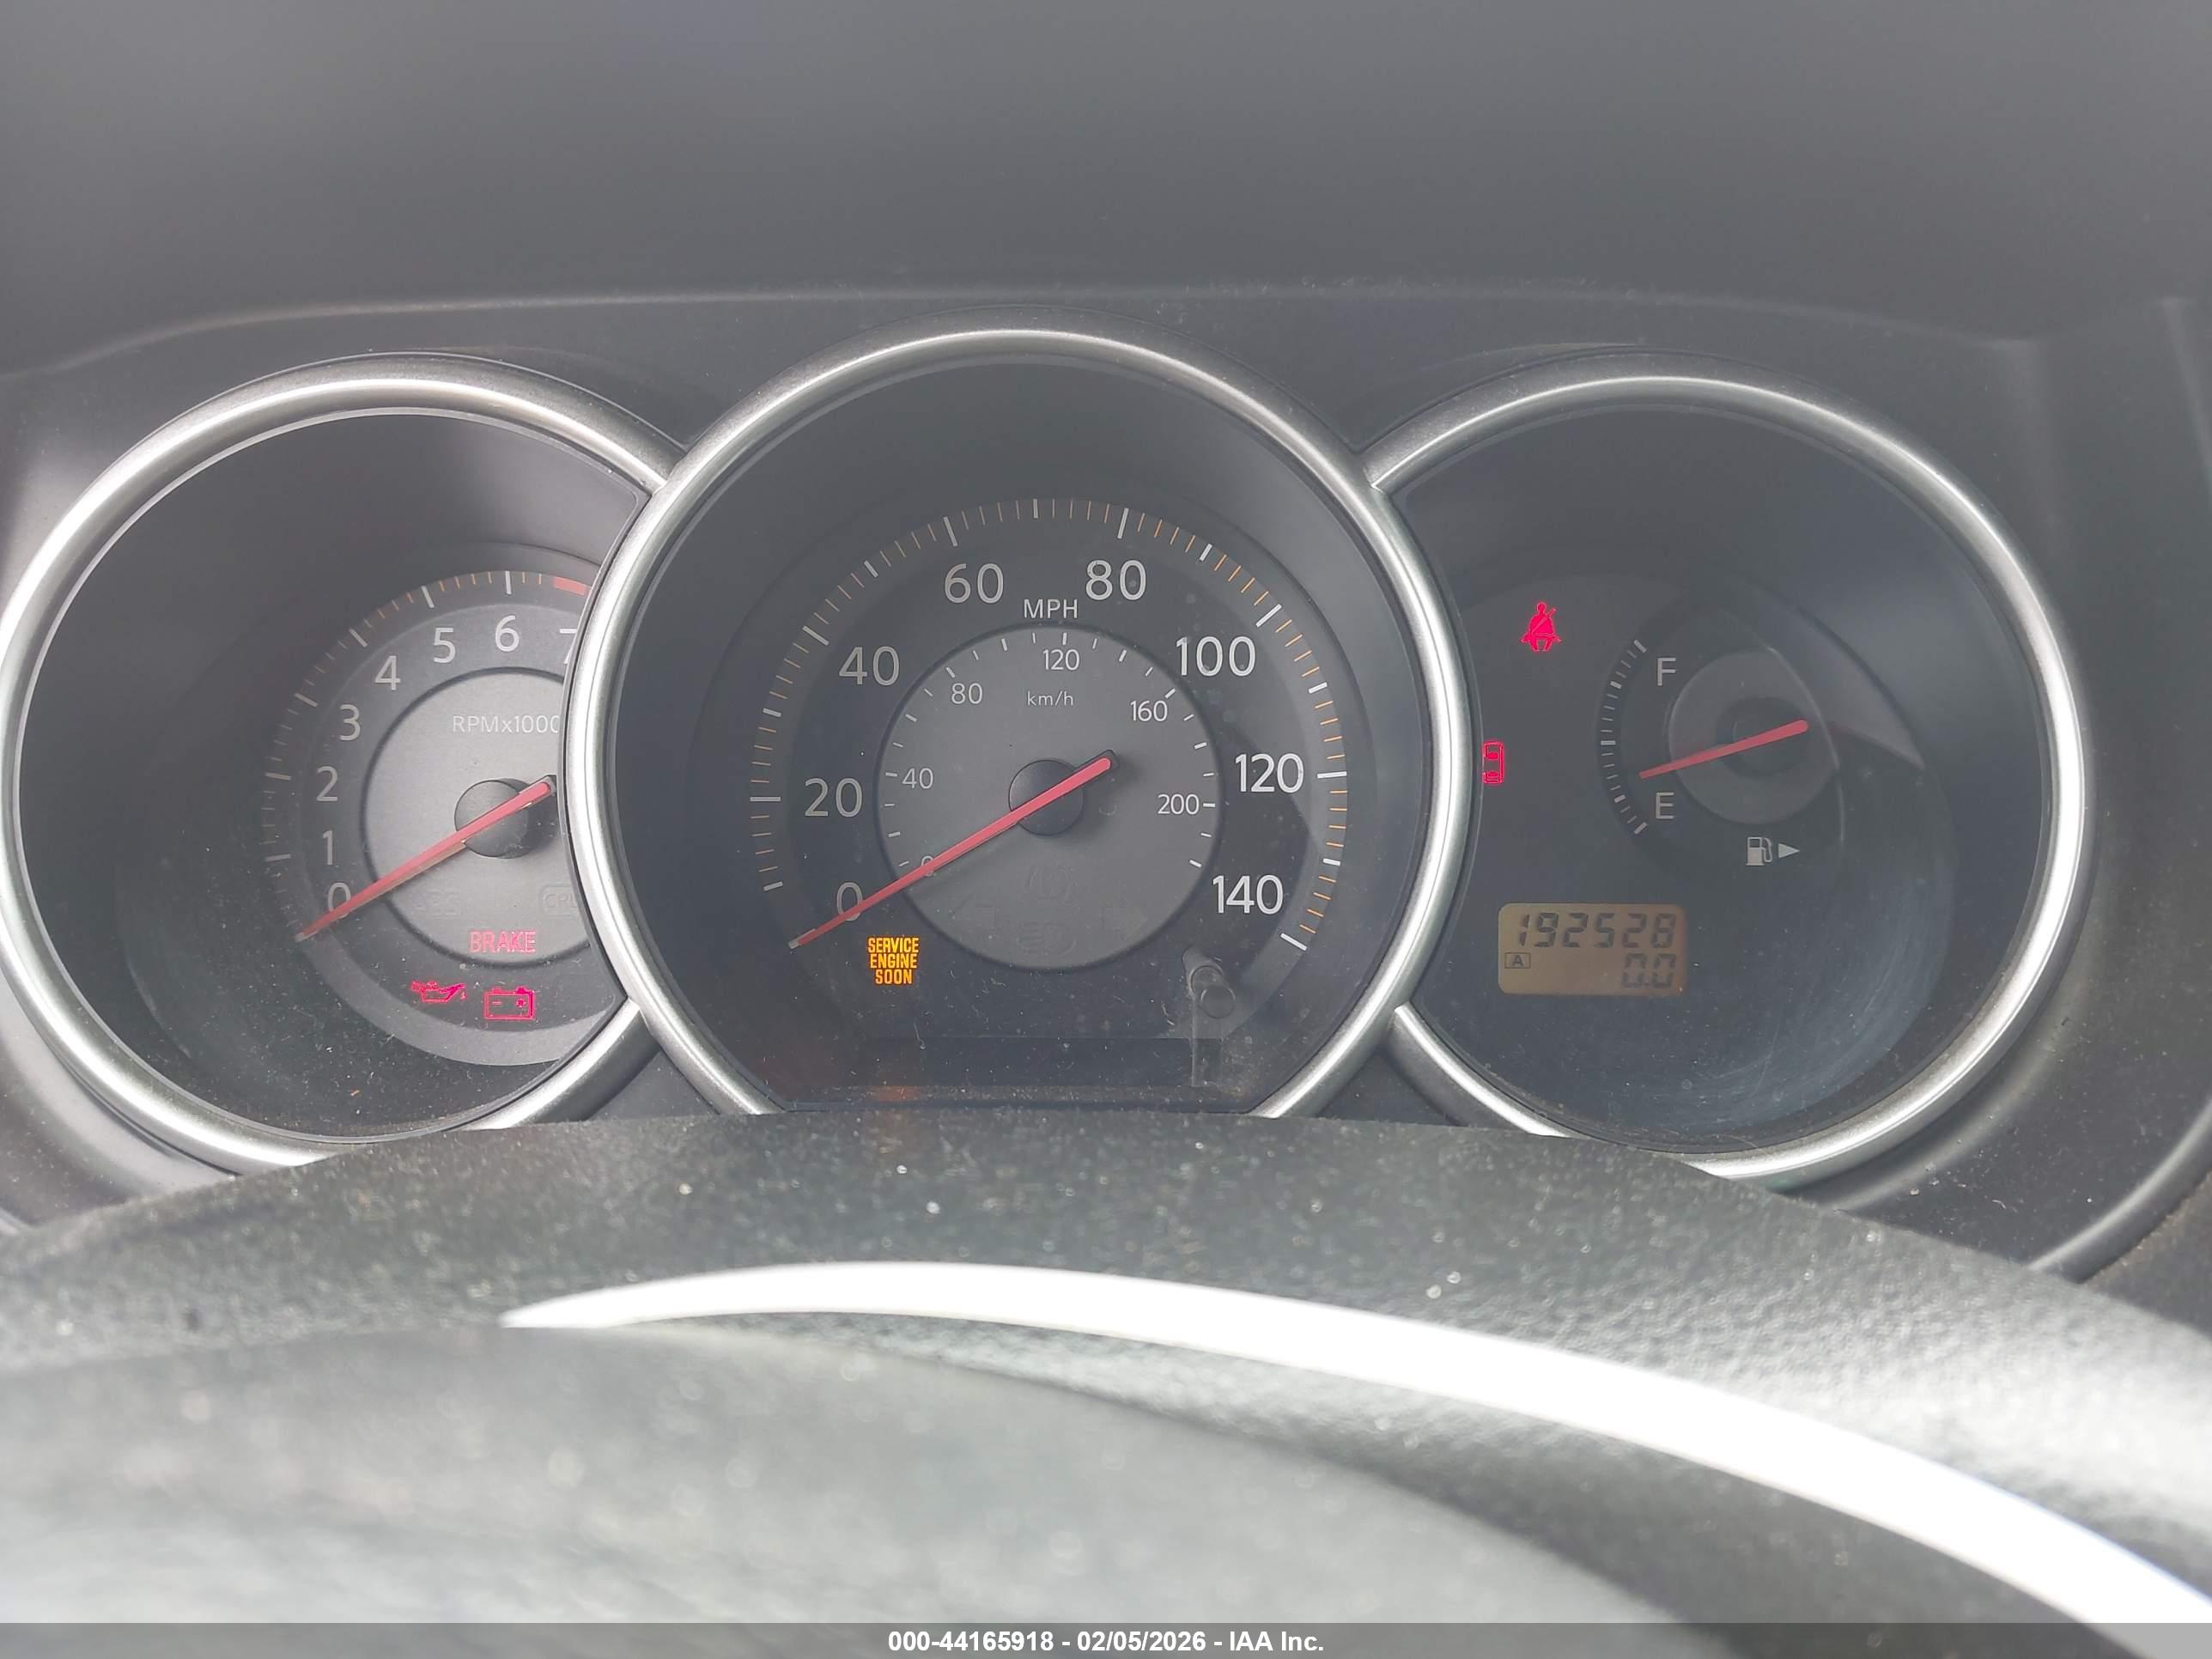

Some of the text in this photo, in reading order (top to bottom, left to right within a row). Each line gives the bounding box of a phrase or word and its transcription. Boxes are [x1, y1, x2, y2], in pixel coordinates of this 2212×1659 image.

[944, 563, 1004, 604] 60
[1085, 560, 1146, 600] 80
[1024, 599, 1078, 619] MPH
[433, 627, 456, 664] 5
[495, 615, 520, 653] 6
[374, 655, 401, 690] 4
[838, 646, 900, 686] 40
[1042, 648, 1080, 671] 120
[1176, 635, 1255, 677] 100
[1656, 657, 1676, 687] F
[951, 683, 982, 705] 80
[1027, 690, 1073, 707] km/h
[1130, 700, 1168, 721] 160
[337, 704, 361, 741] 3
[316, 766, 338, 802] 2
[902, 768, 933, 789] 40
[1235, 752, 1304, 793] 120
[805, 777, 863, 817] 20
[1158, 793, 1200, 815] 200
[1656, 792, 1674, 820] E
[322, 830, 334, 866] 1
[327, 882, 351, 918] 0
[836, 881, 864, 921] 0
[1212, 874, 1284, 915] 140
[470, 930, 537, 954] BRAKE
[866, 937, 920, 953] SERVICE
[1518, 912, 1677, 948] 192528
[869, 953, 918, 969] ENGINE
[875, 969, 913, 985] SOON
[1621, 952, 1677, 988] 0.0
